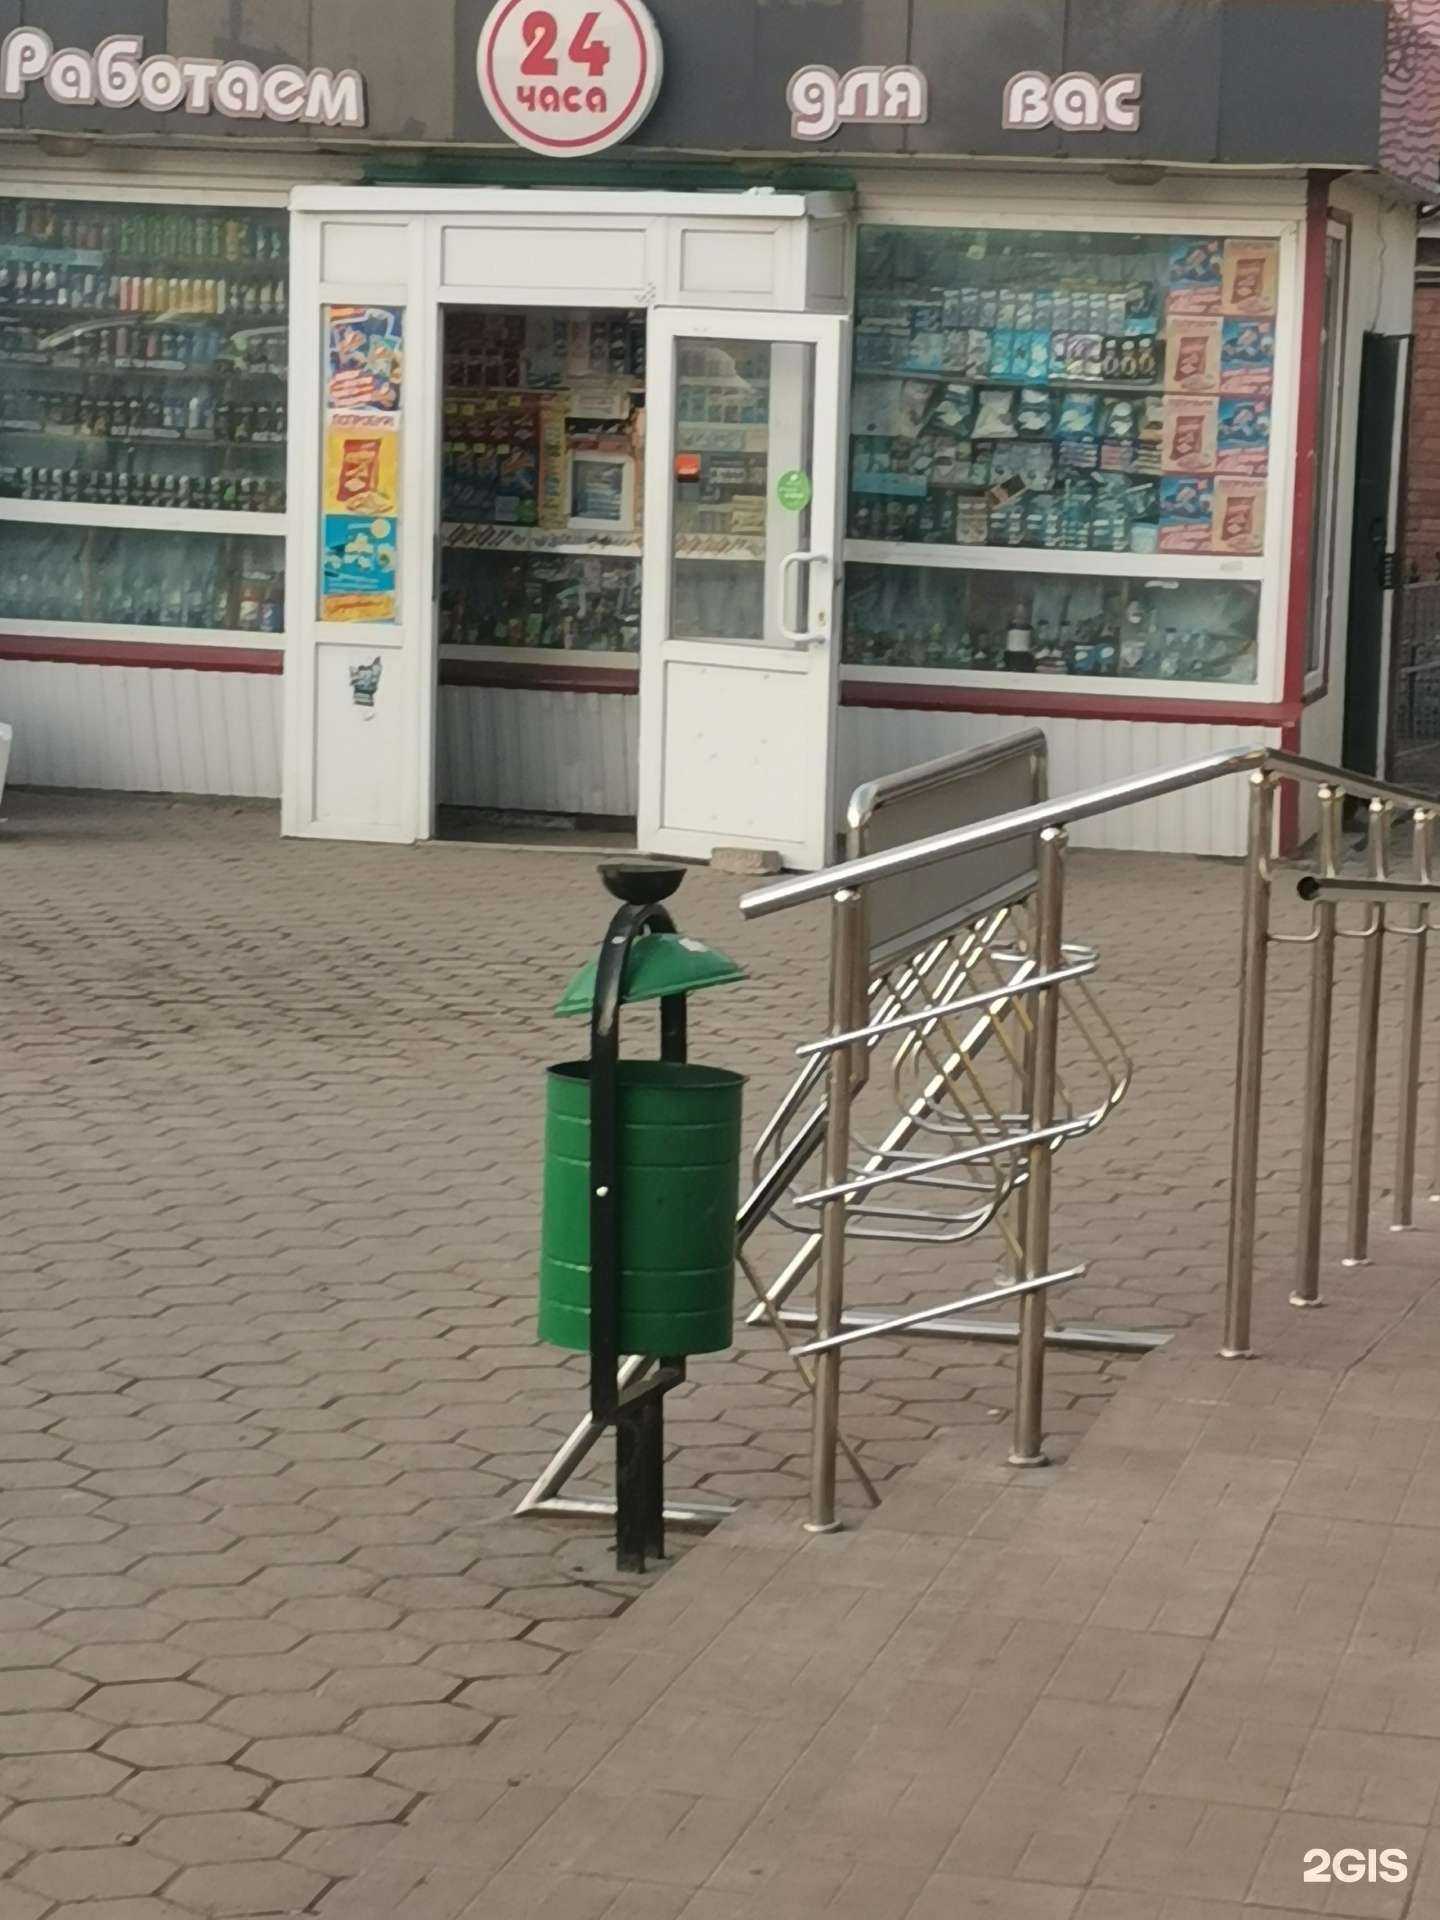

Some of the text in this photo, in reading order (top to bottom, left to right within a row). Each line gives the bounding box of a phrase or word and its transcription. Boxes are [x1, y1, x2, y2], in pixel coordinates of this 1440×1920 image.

[3, 30, 364, 124] Работаем
[521, 11, 610, 77] 24
[516, 86, 608, 113] часа
[790, 71, 1140, 138] для вас
